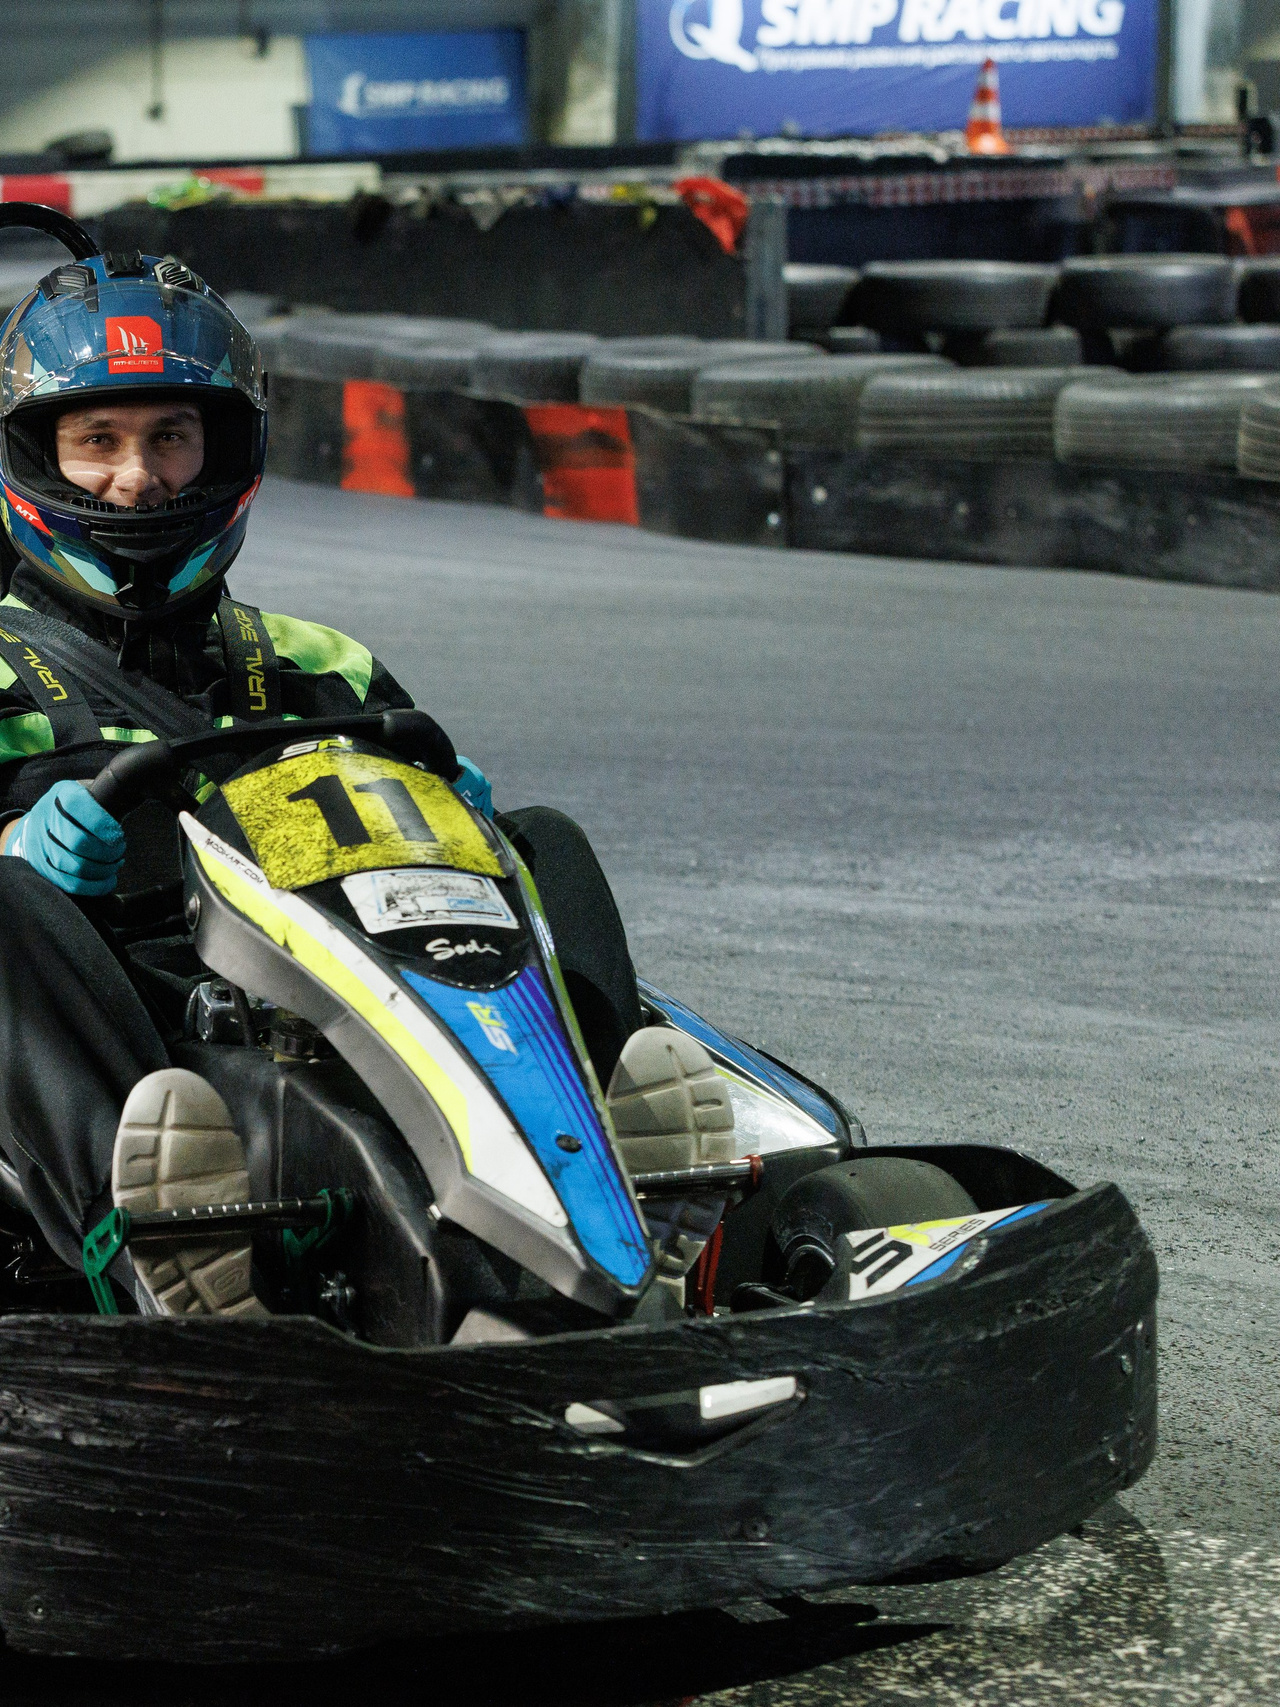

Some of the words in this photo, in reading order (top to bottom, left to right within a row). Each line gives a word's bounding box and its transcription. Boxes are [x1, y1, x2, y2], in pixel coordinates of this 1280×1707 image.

[756, 0, 898, 46] SMP
[898, 0, 1125, 42] RACING
[15, 504, 40, 521] MT
[23, 647, 68, 701] URAL
[245, 648, 267, 711] URAL
[286, 775, 439, 848] 11
[928, 1217, 987, 1252] SERIES
